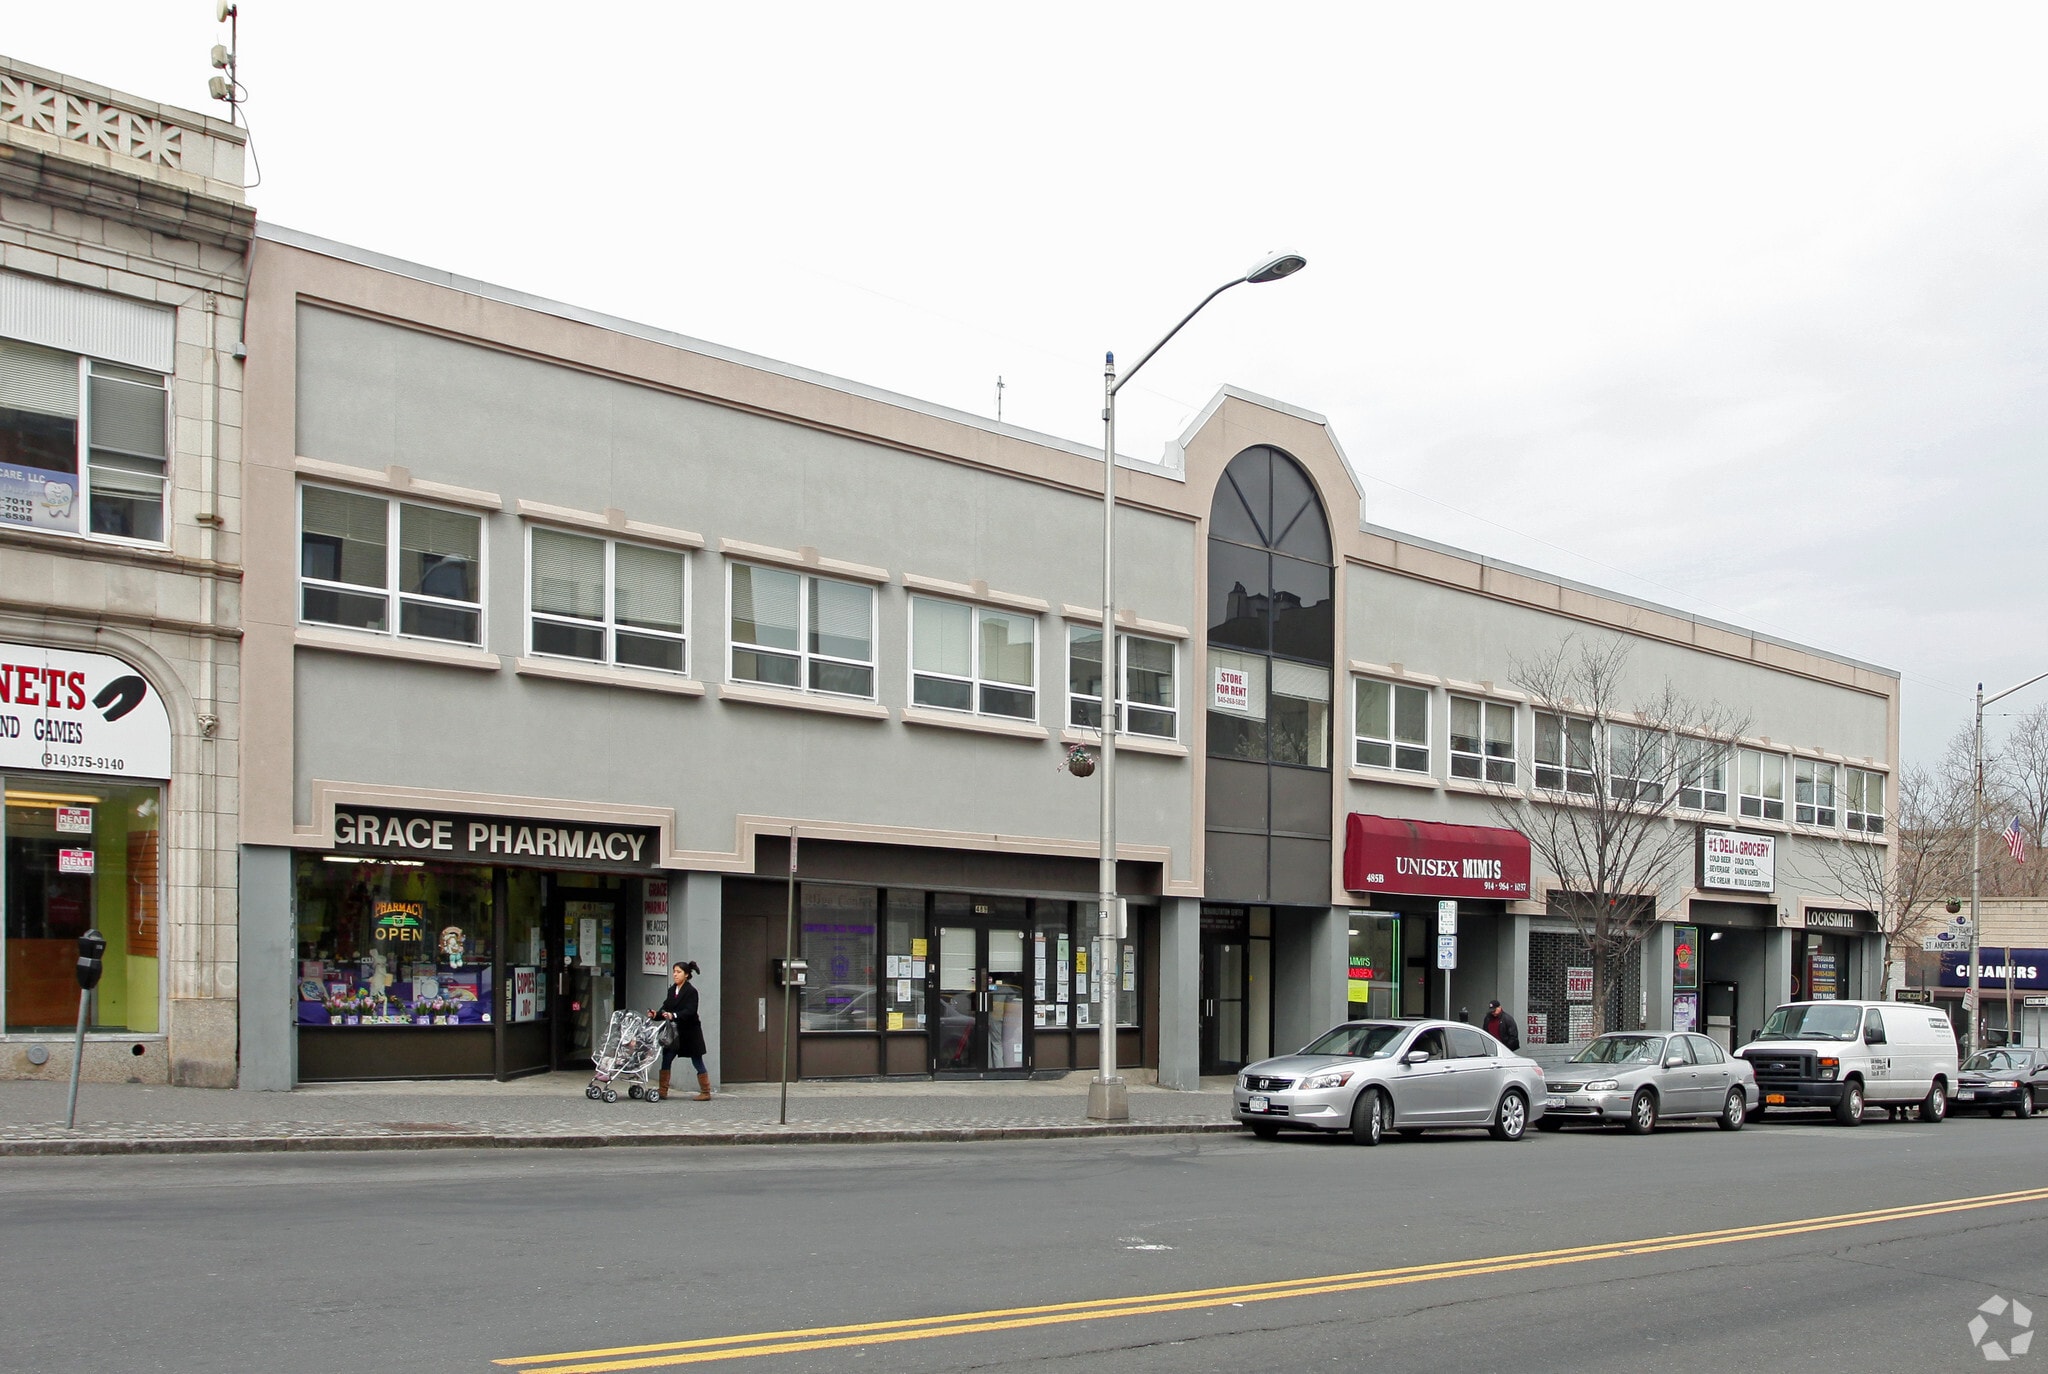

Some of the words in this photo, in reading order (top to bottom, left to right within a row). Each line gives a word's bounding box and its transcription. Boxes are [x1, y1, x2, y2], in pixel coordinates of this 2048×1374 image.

[28, 472, 46, 484] LLC
[1221, 672, 1242, 685] STORE
[1216, 683, 1230, 695] FOR
[1230, 685, 1247, 698] RENT
[0, 714, 21, 739] ND
[34, 718, 82, 744] GAMES
[41, 752, 124, 770] (914)375-9140
[59, 814, 90, 824] RENT
[334, 812, 453, 850] GRACE
[468, 822, 646, 862] PHARMACY
[1708, 837, 1718, 853] #1
[1719, 838, 1735, 854] DELI
[1739, 840, 1770, 858] GROCERY
[62, 856, 92, 866] RENT
[1396, 856, 1459, 878] UNISEX
[1709, 854, 1721, 863] COLD
[1720, 855, 1732, 864] BEER
[1734, 857, 1745, 866] COLD
[1744, 858, 1755, 867] CUTS
[1709, 864, 1731, 874] BEVERAGE
[1734, 867, 1760, 877] SANDWICHES
[1366, 873, 1385, 884] 485B
[1484, 881, 1495, 890] 914
[1716, 876, 1731, 885] CREAM
[648, 883, 667, 897] GRACE
[375, 901, 424, 919] PHARMACY
[1806, 911, 1854, 928] LOCKSMITH
[375, 927, 423, 941] OPEN
[1925, 941, 1932, 950] ST
[1933, 941, 1959, 950] ANDREWS
[1960, 942, 1968, 950] PL
[517, 972, 535, 995] COPIES
[1568, 977, 1592, 991] RENT
[1823, 992, 1836, 1000] MADE
